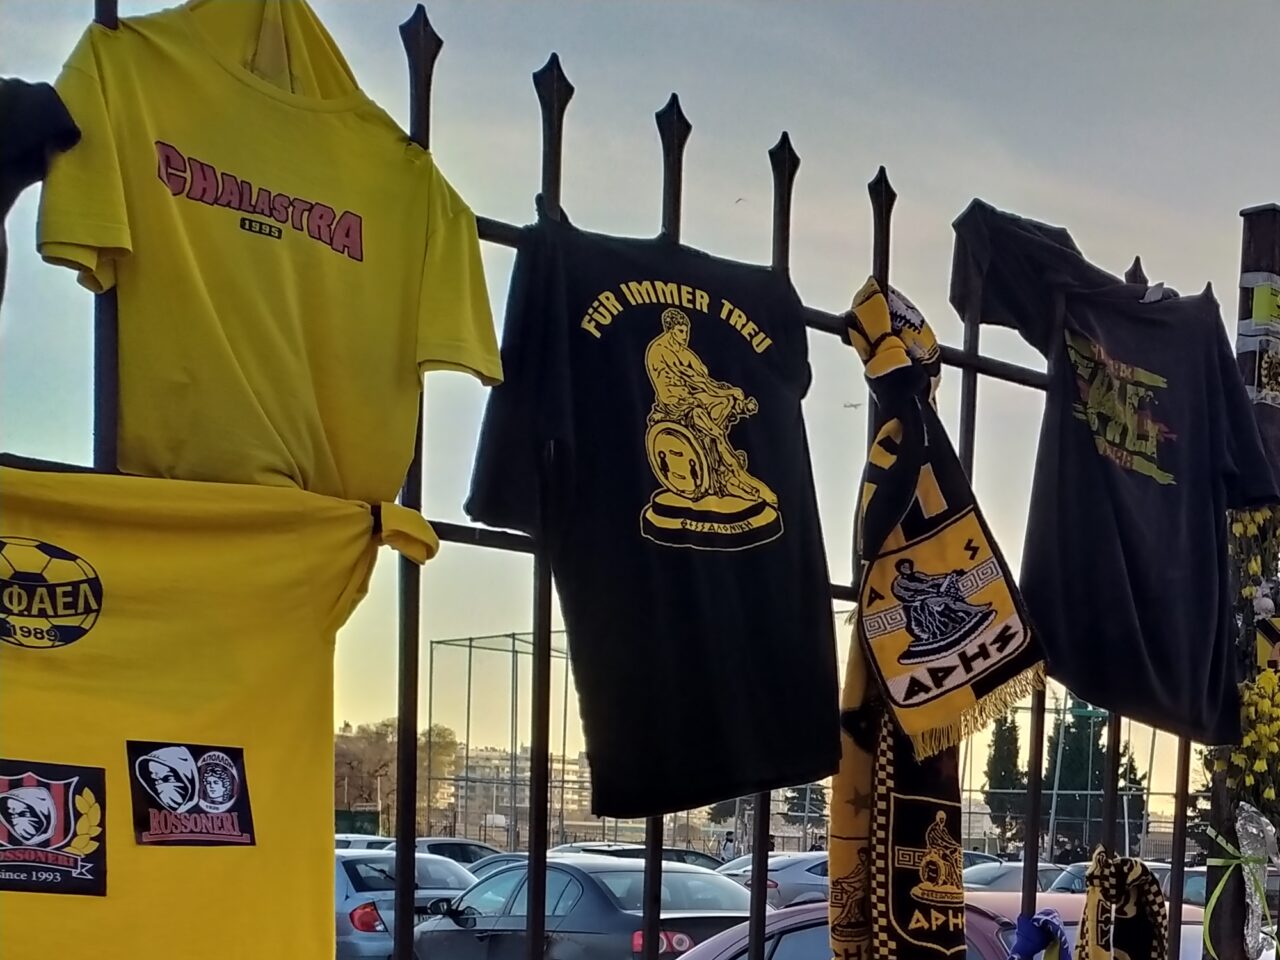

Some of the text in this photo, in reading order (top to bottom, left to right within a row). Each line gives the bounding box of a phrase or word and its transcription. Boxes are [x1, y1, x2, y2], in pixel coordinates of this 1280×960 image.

[155, 140, 363, 262] CHALASTRA
[243, 219, 280, 238] 1995
[580, 280, 773, 354] FÜR IMMER TREU
[9, 623, 57, 642] 1989
[149, 808, 242, 836] ROSSONERI
[31, 871, 62, 883] 1993
[908, 908, 965, 932] ΑΡΗ
